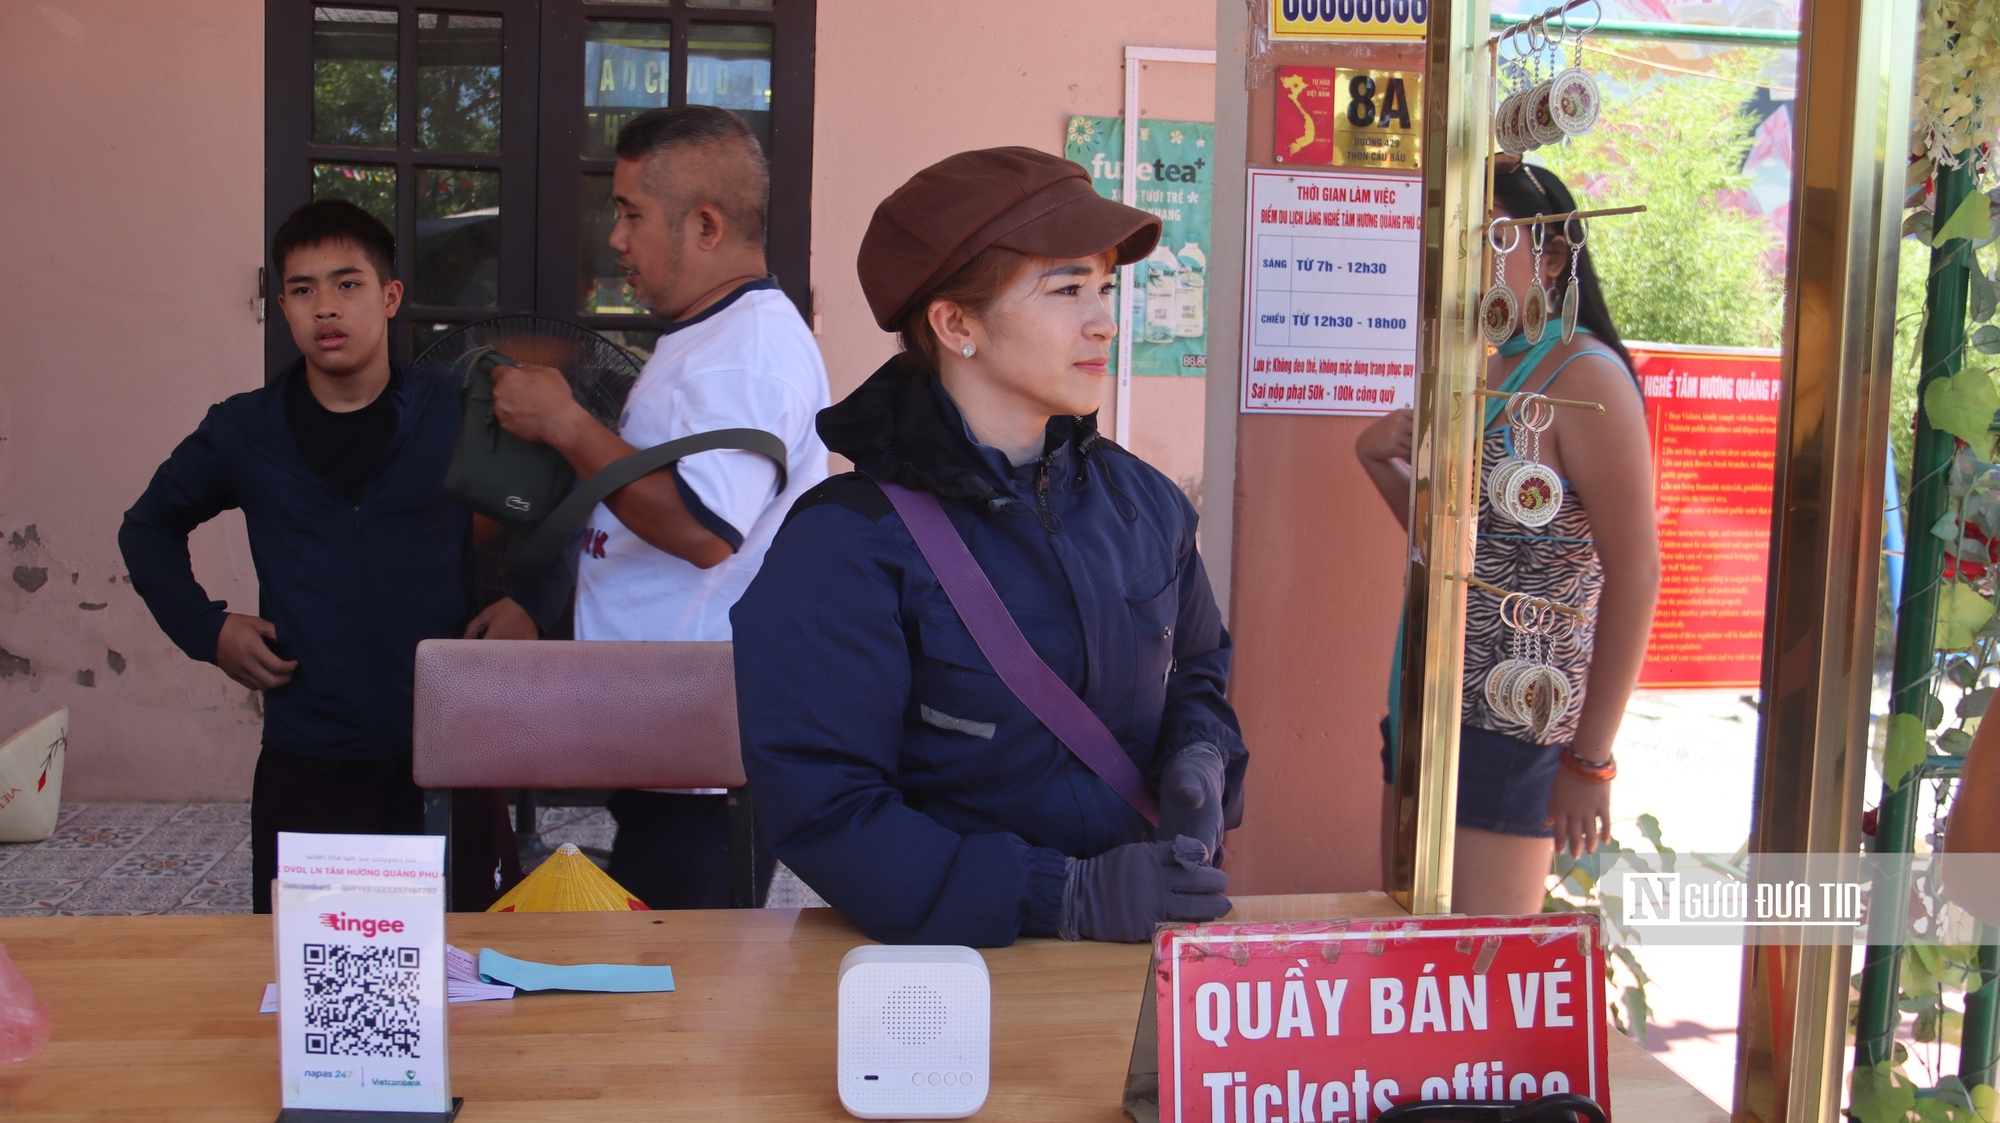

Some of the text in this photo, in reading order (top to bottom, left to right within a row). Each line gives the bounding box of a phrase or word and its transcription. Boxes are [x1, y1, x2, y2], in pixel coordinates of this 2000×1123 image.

[1347, 75, 1412, 129] 8A
[1384, 138, 1400, 148] 429
[1297, 183, 1396, 207] THỜI GIAN LÀM VIỆC
[1261, 204, 1278, 224] ĐIỂM
[1279, 210, 1288, 225] DU
[1289, 211, 1303, 228] LỊCH
[1305, 208, 1321, 226] LÀNG
[1357, 212, 1378, 229] HƯƠNG
[1380, 210, 1401, 230] QUẢNG
[1402, 212, 1414, 230] PHÚ
[1263, 259, 1287, 268] SÁNG
[1297, 259, 1314, 272] TỪ
[1317, 261, 1333, 272] 7h
[1347, 262, 1387, 274] 12h30
[1292, 314, 1310, 326] TỪ
[1313, 316, 1353, 328] 12h30
[1367, 317, 1406, 330] 18h00
[1253, 357, 1264, 372] Lưu
[1273, 358, 1292, 374] Không
[1293, 359, 1304, 374] đeo
[1319, 359, 1337, 376] không
[1339, 361, 1352, 378] mặc
[1354, 361, 1368, 377] đúng
[1370, 362, 1385, 377] trang
[1387, 363, 1401, 379] phục
[1252, 383, 1266, 399] Sai
[1268, 383, 1284, 403] nộp
[1286, 384, 1306, 404] phạt
[1308, 385, 1324, 400] 50k
[1333, 385, 1354, 401] 100k
[1356, 387, 1376, 404] công
[1379, 387, 1396, 404] quỹ
[283, 865, 308, 874] DVDL
[310, 867, 323, 875] LN
[320, 911, 405, 938] tingee
[1194, 959, 1574, 1048] QUẦY BÁN VÉ
[304, 1070, 332, 1079] napas
[371, 1078, 422, 1086] Vietcombank
